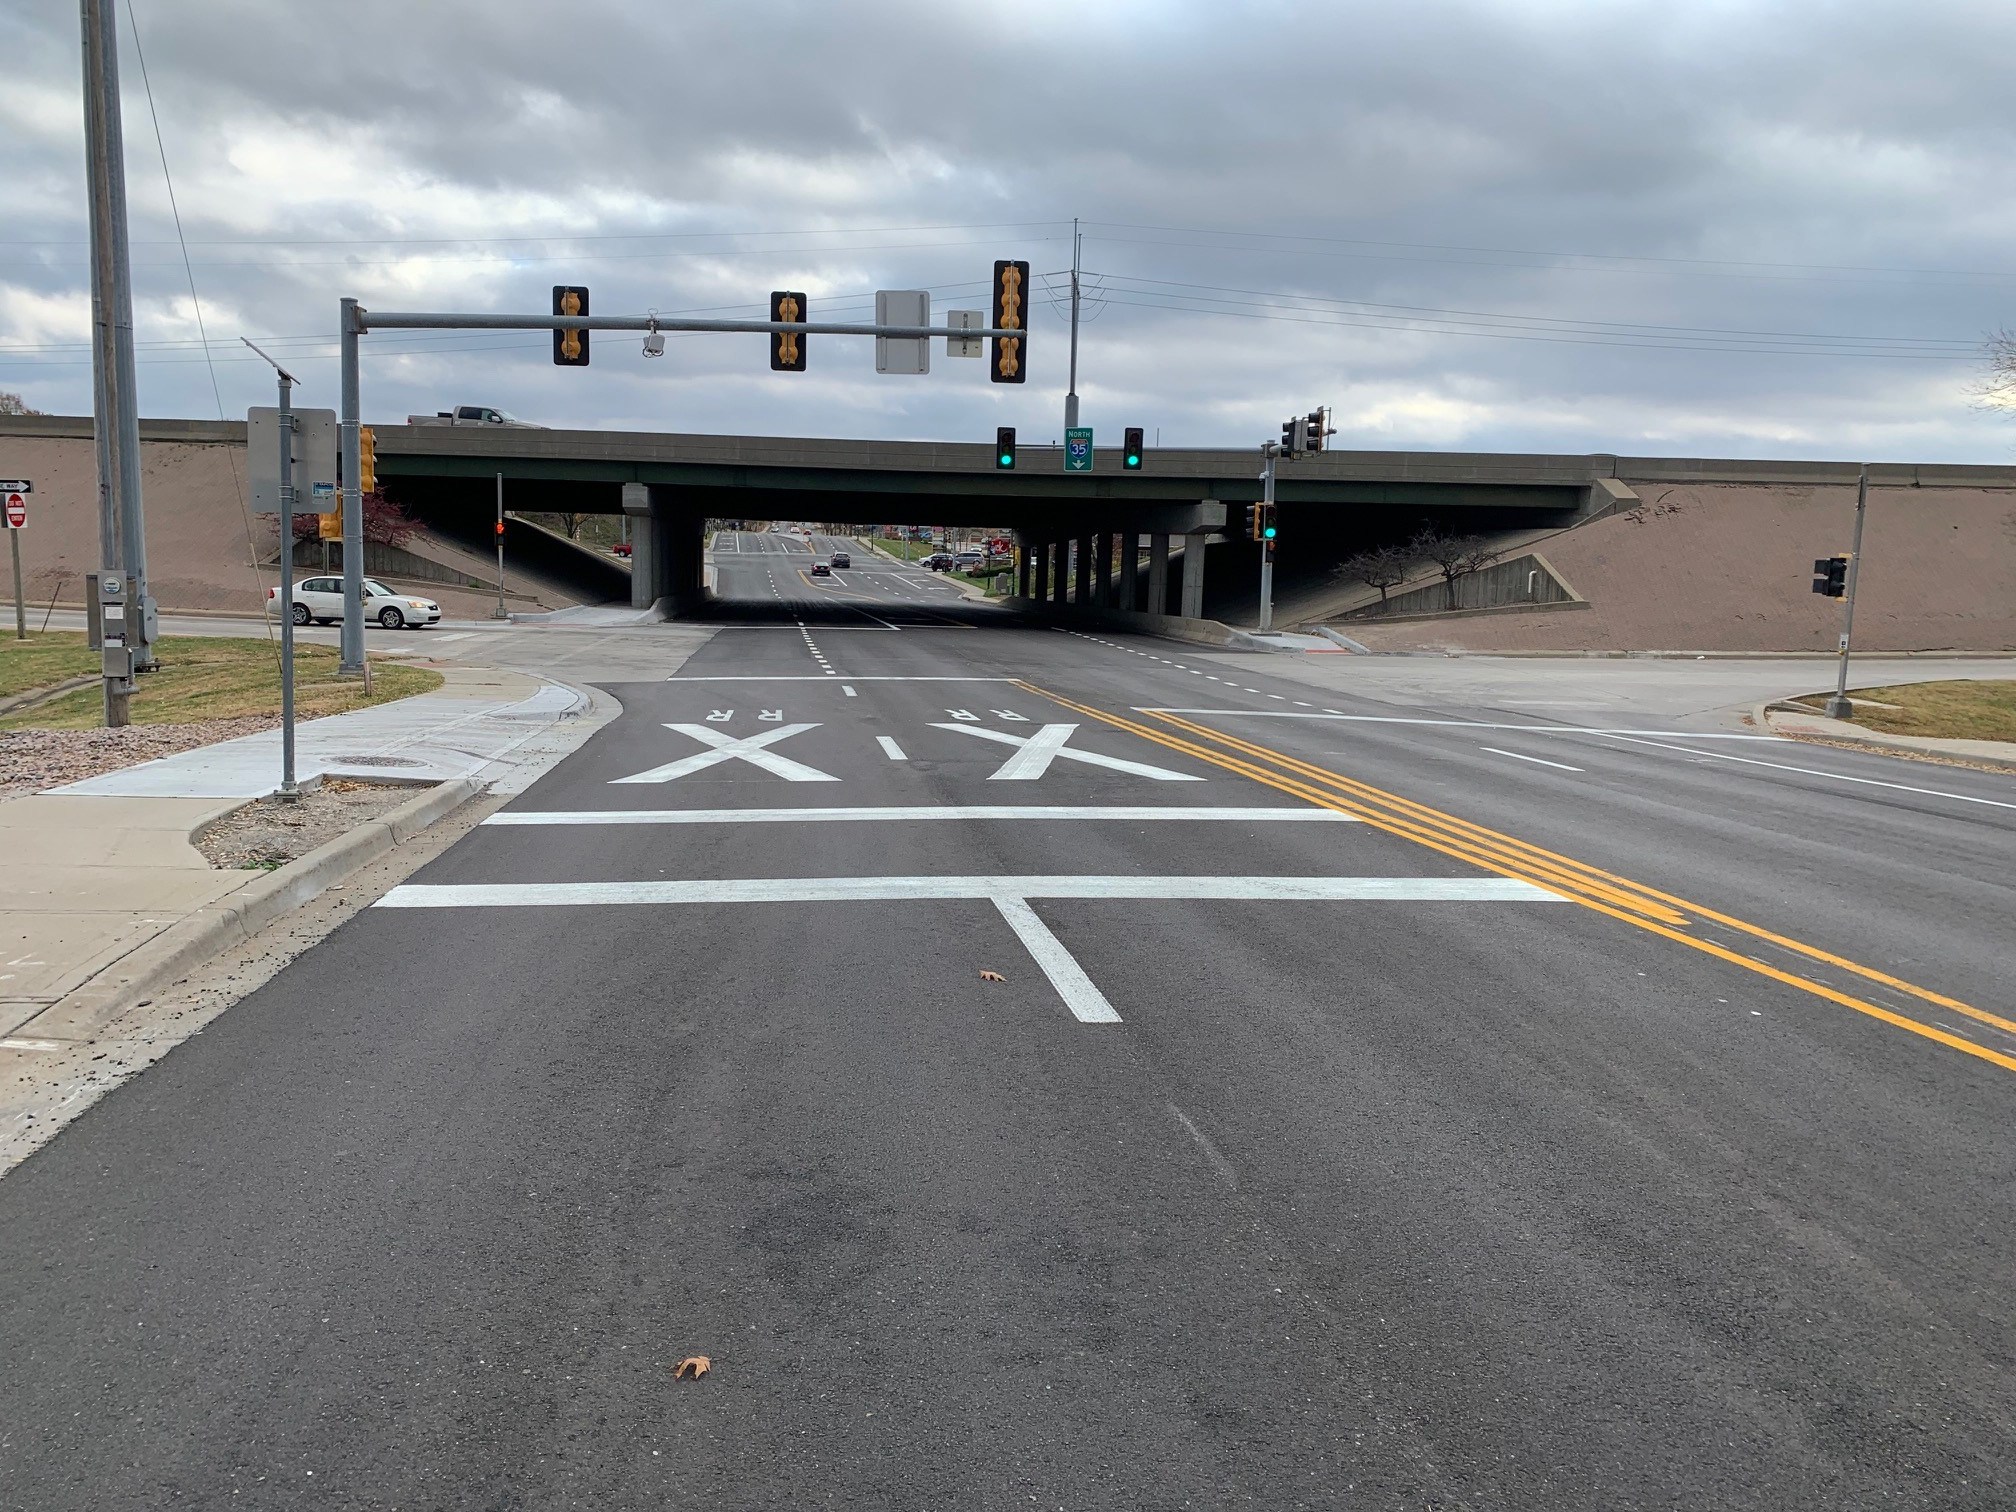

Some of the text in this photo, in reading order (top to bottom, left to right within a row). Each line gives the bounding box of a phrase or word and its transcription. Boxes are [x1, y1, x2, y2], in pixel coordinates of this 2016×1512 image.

[1072, 444, 1086, 455] 35
[706, 709, 783, 721] R R
